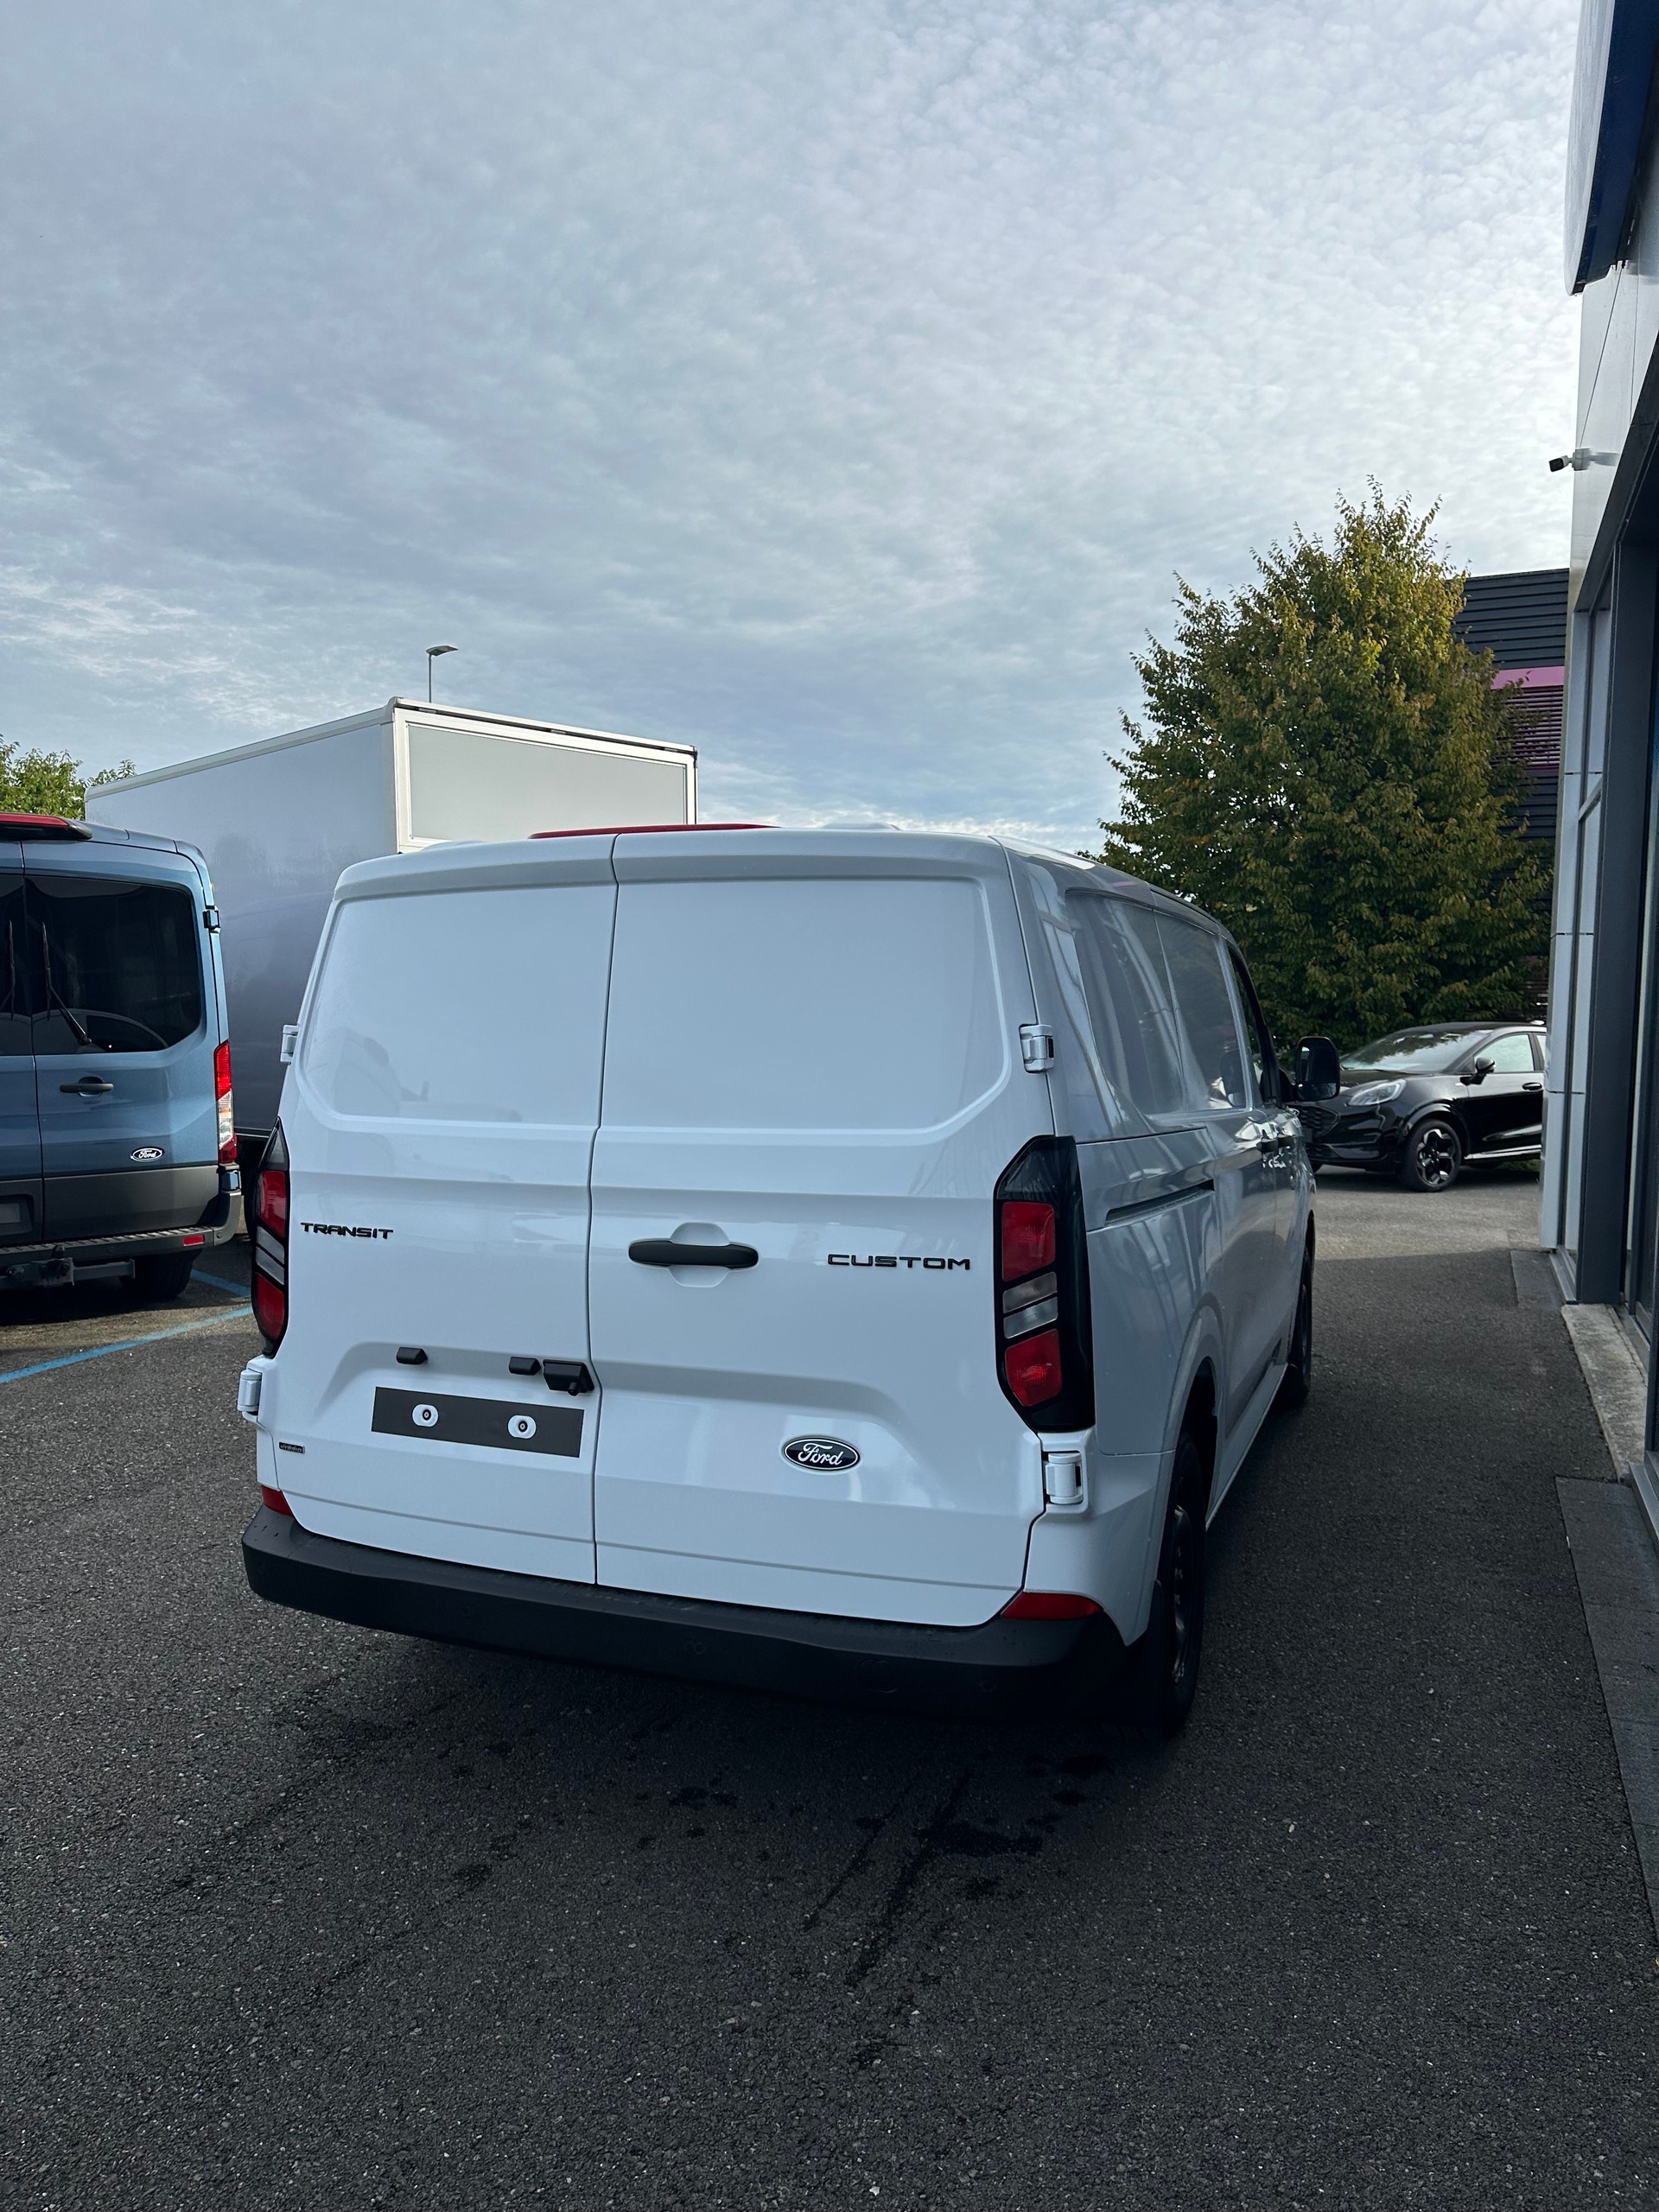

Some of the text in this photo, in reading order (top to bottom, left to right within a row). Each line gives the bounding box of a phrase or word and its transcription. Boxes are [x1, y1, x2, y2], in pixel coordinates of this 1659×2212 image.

[300, 1222, 394, 1240] TRANSIT
[827, 1253, 970, 1270] CUSTOM
[798, 1442, 844, 1465] Ford
